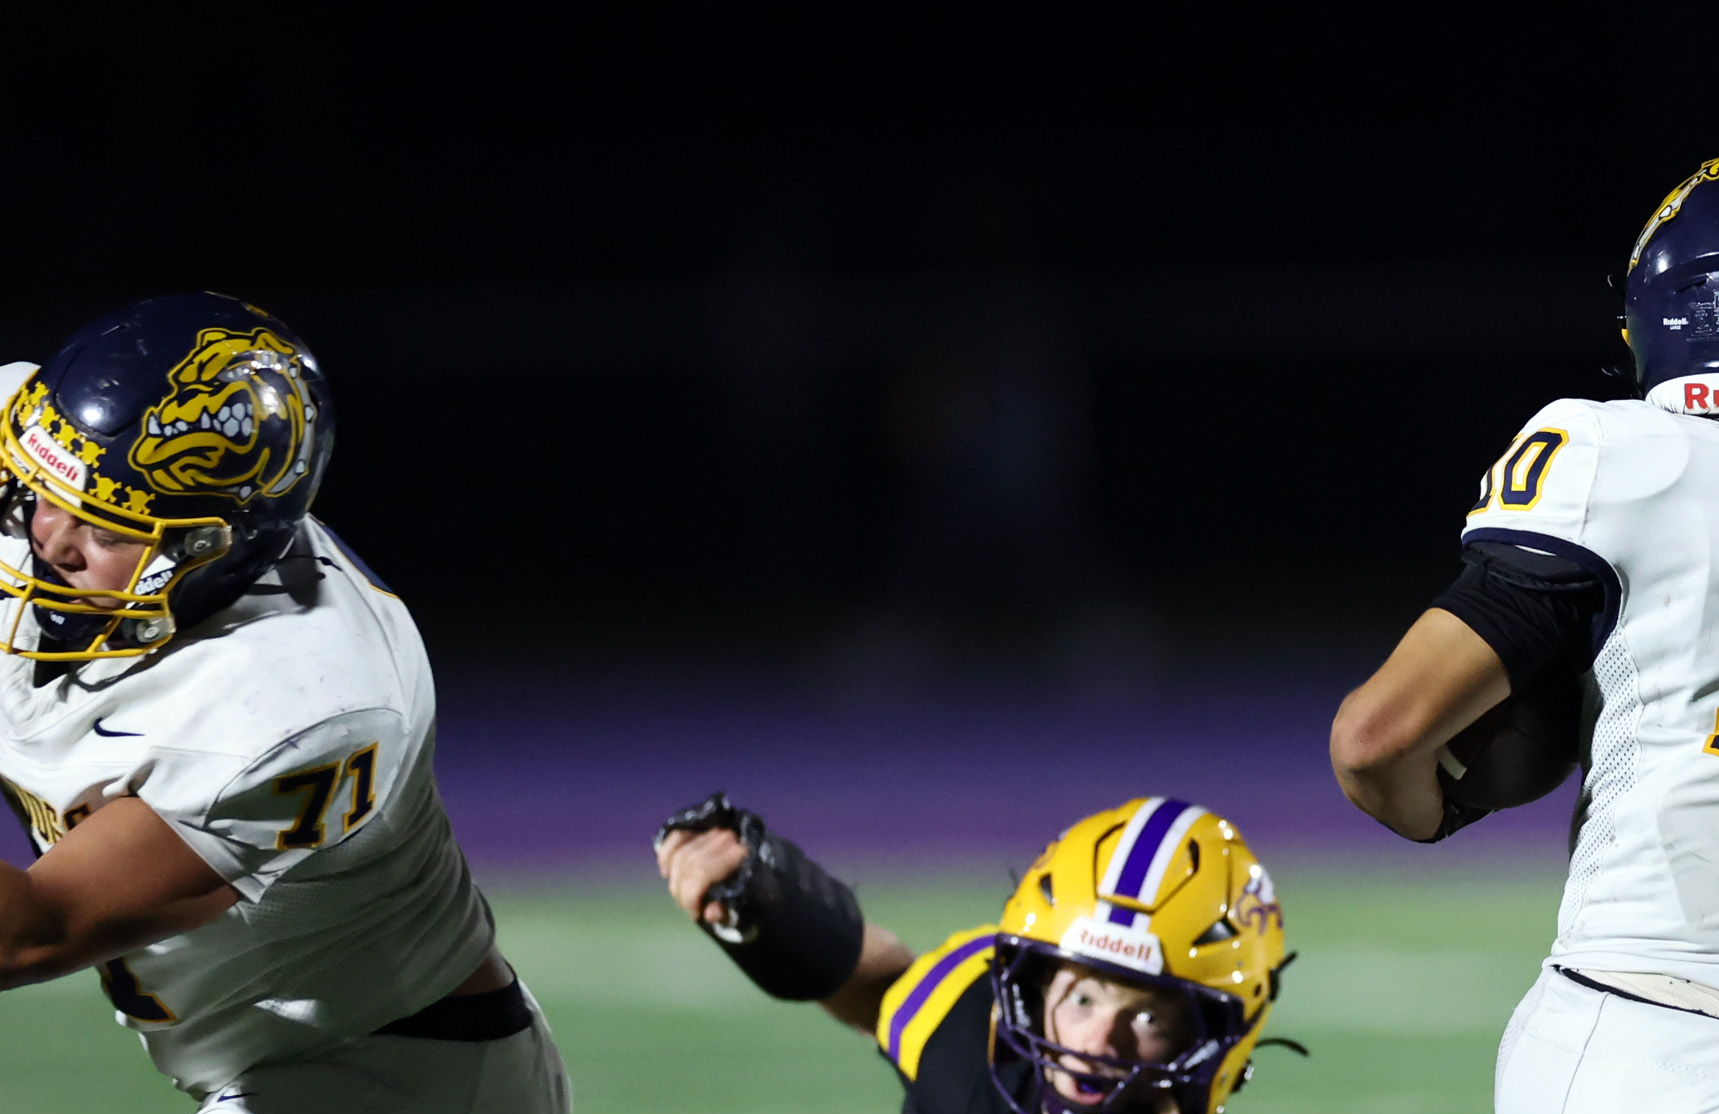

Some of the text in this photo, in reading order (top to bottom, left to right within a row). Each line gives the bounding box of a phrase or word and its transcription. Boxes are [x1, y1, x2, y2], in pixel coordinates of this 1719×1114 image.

[27, 433, 80, 482] Riddell
[134, 570, 174, 596] ddell
[272, 740, 379, 851] 71
